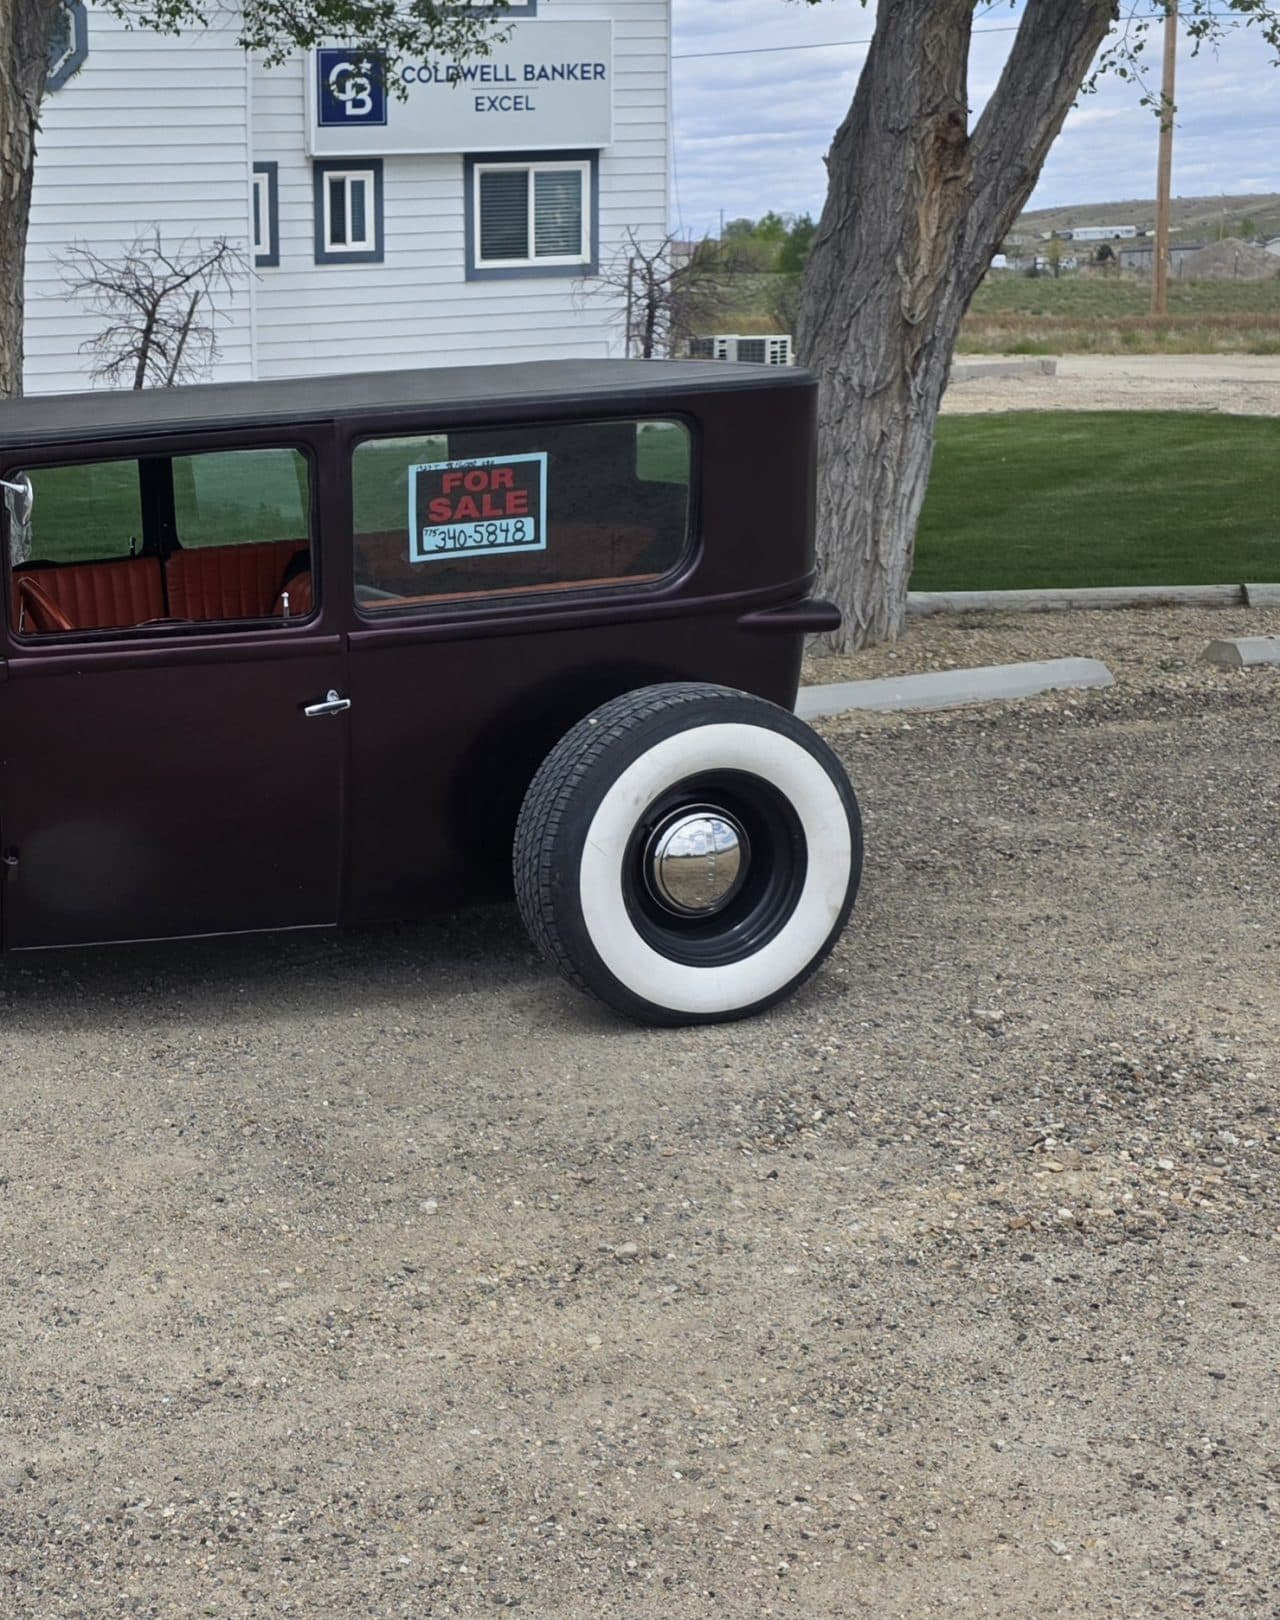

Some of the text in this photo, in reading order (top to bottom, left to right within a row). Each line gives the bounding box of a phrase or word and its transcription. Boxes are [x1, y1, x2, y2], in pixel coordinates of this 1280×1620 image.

[401, 62, 606, 84] COLDWELL BANKER
[474, 95, 536, 112] EXCEL
[442, 468, 514, 494] FOR
[428, 490, 529, 522] SALE
[435, 520, 526, 550] 340-5848
